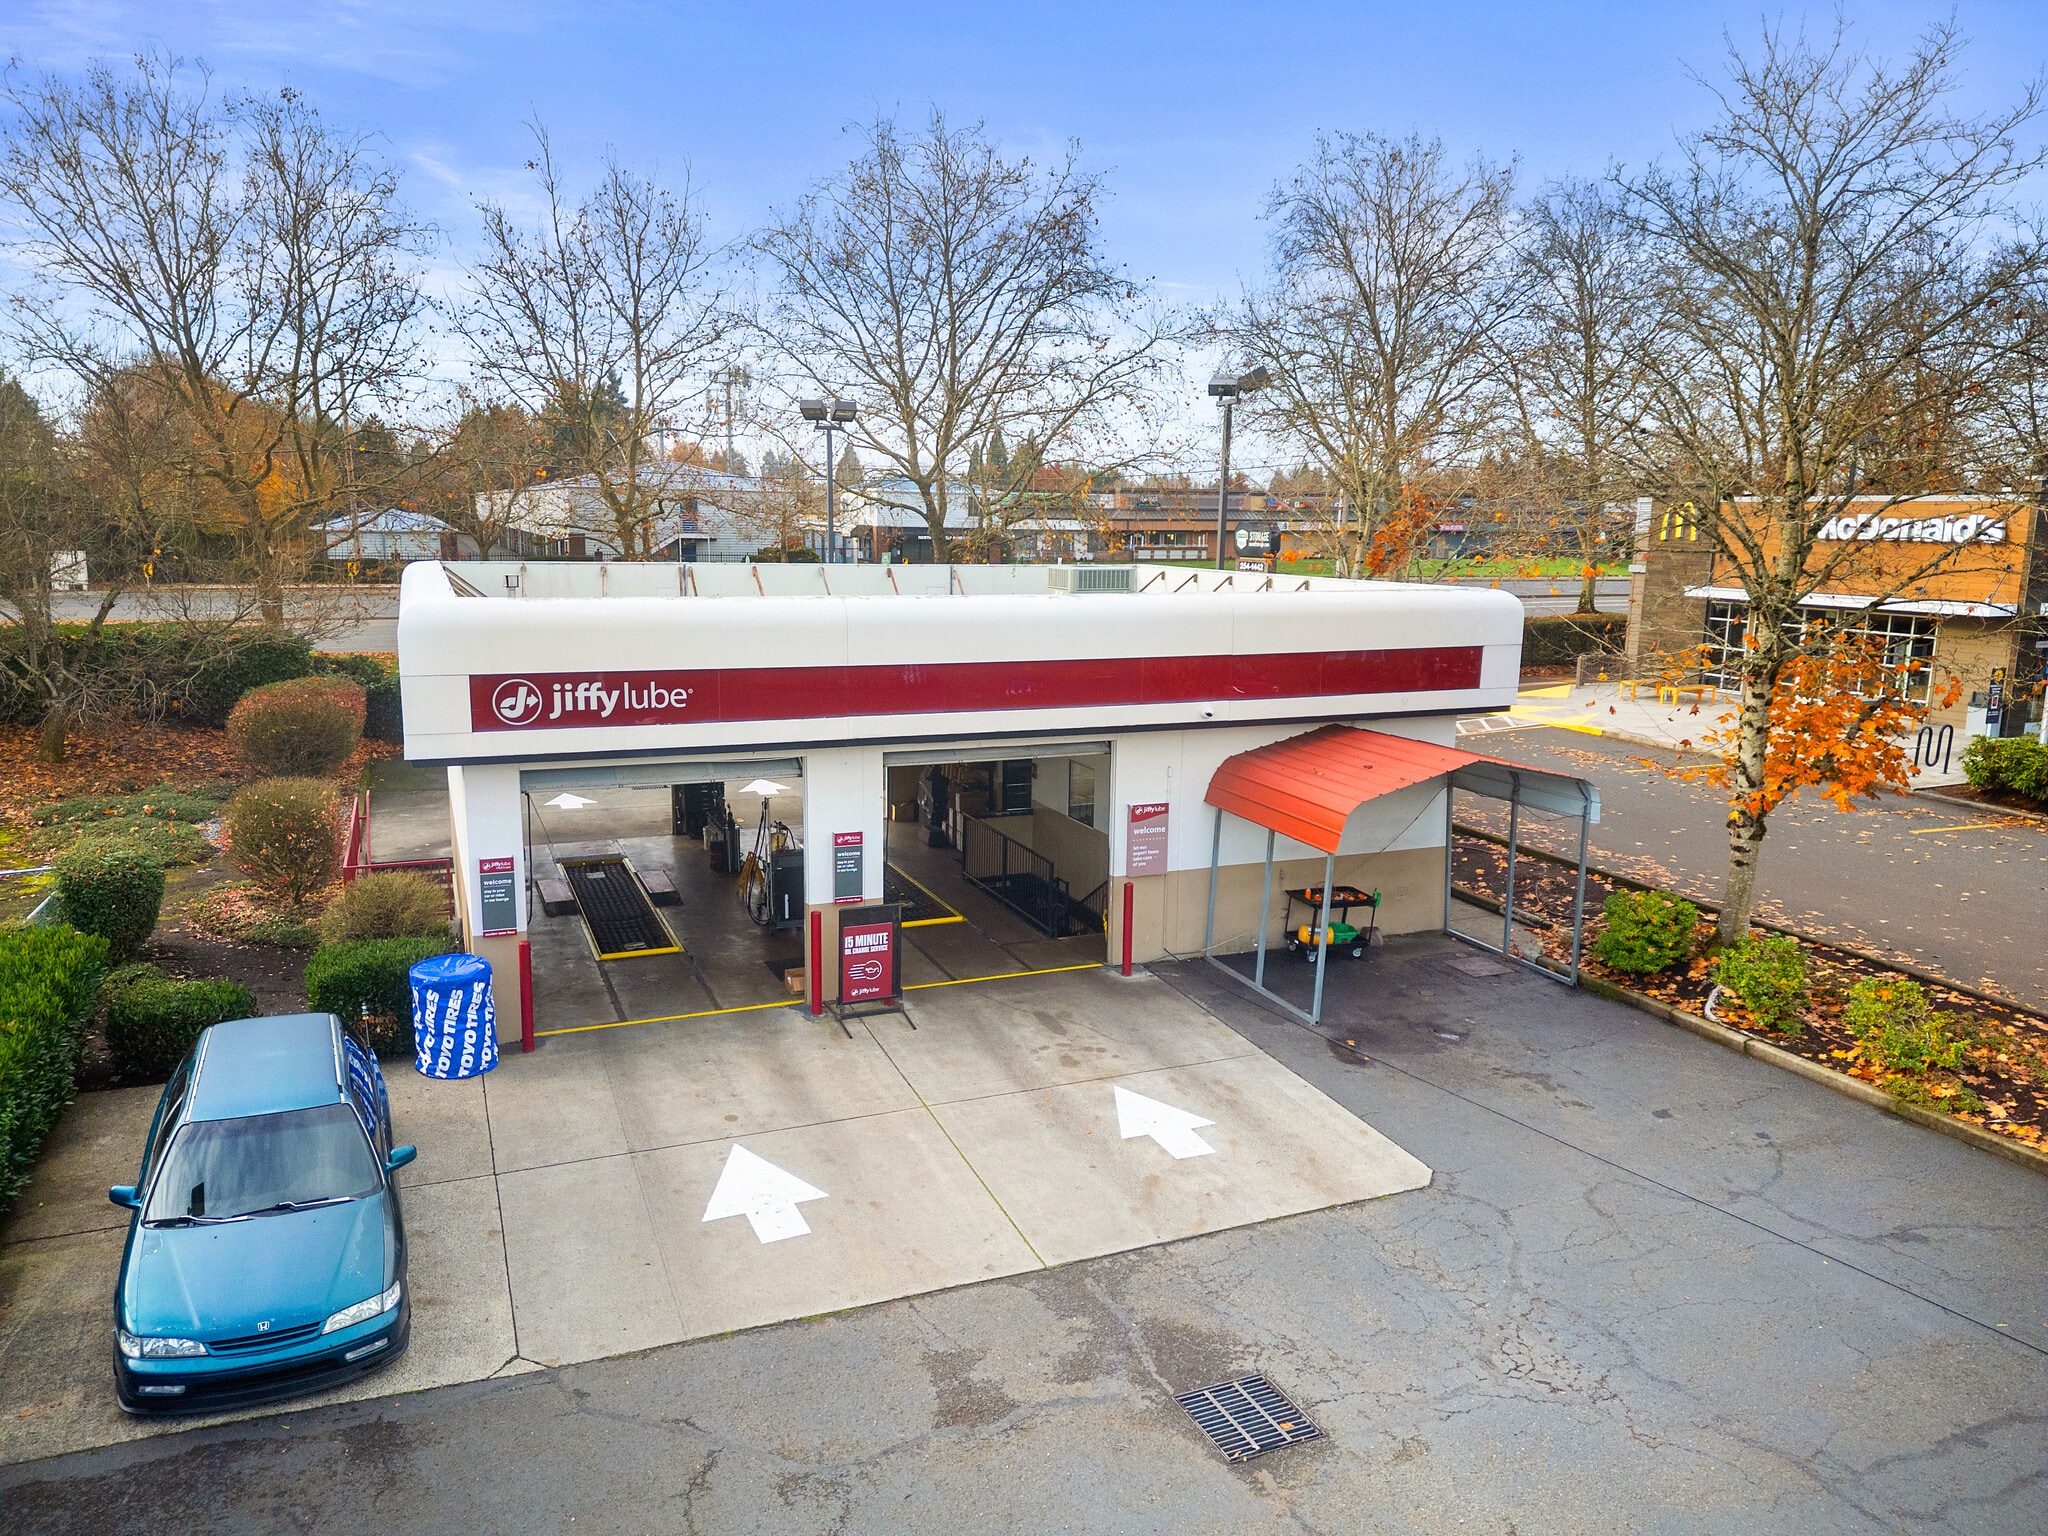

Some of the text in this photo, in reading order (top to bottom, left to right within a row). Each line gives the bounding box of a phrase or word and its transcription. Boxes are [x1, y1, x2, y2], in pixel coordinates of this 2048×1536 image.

[1250, 532, 1270, 541] STORAGE
[549, 682, 620, 720] jiffy
[1133, 826, 1166, 835] welcome
[845, 932, 888, 948] 15 MINUTE
[435, 989, 463, 1078] TOYO TIRES
[458, 982, 485, 1077] TOYO TIRES
